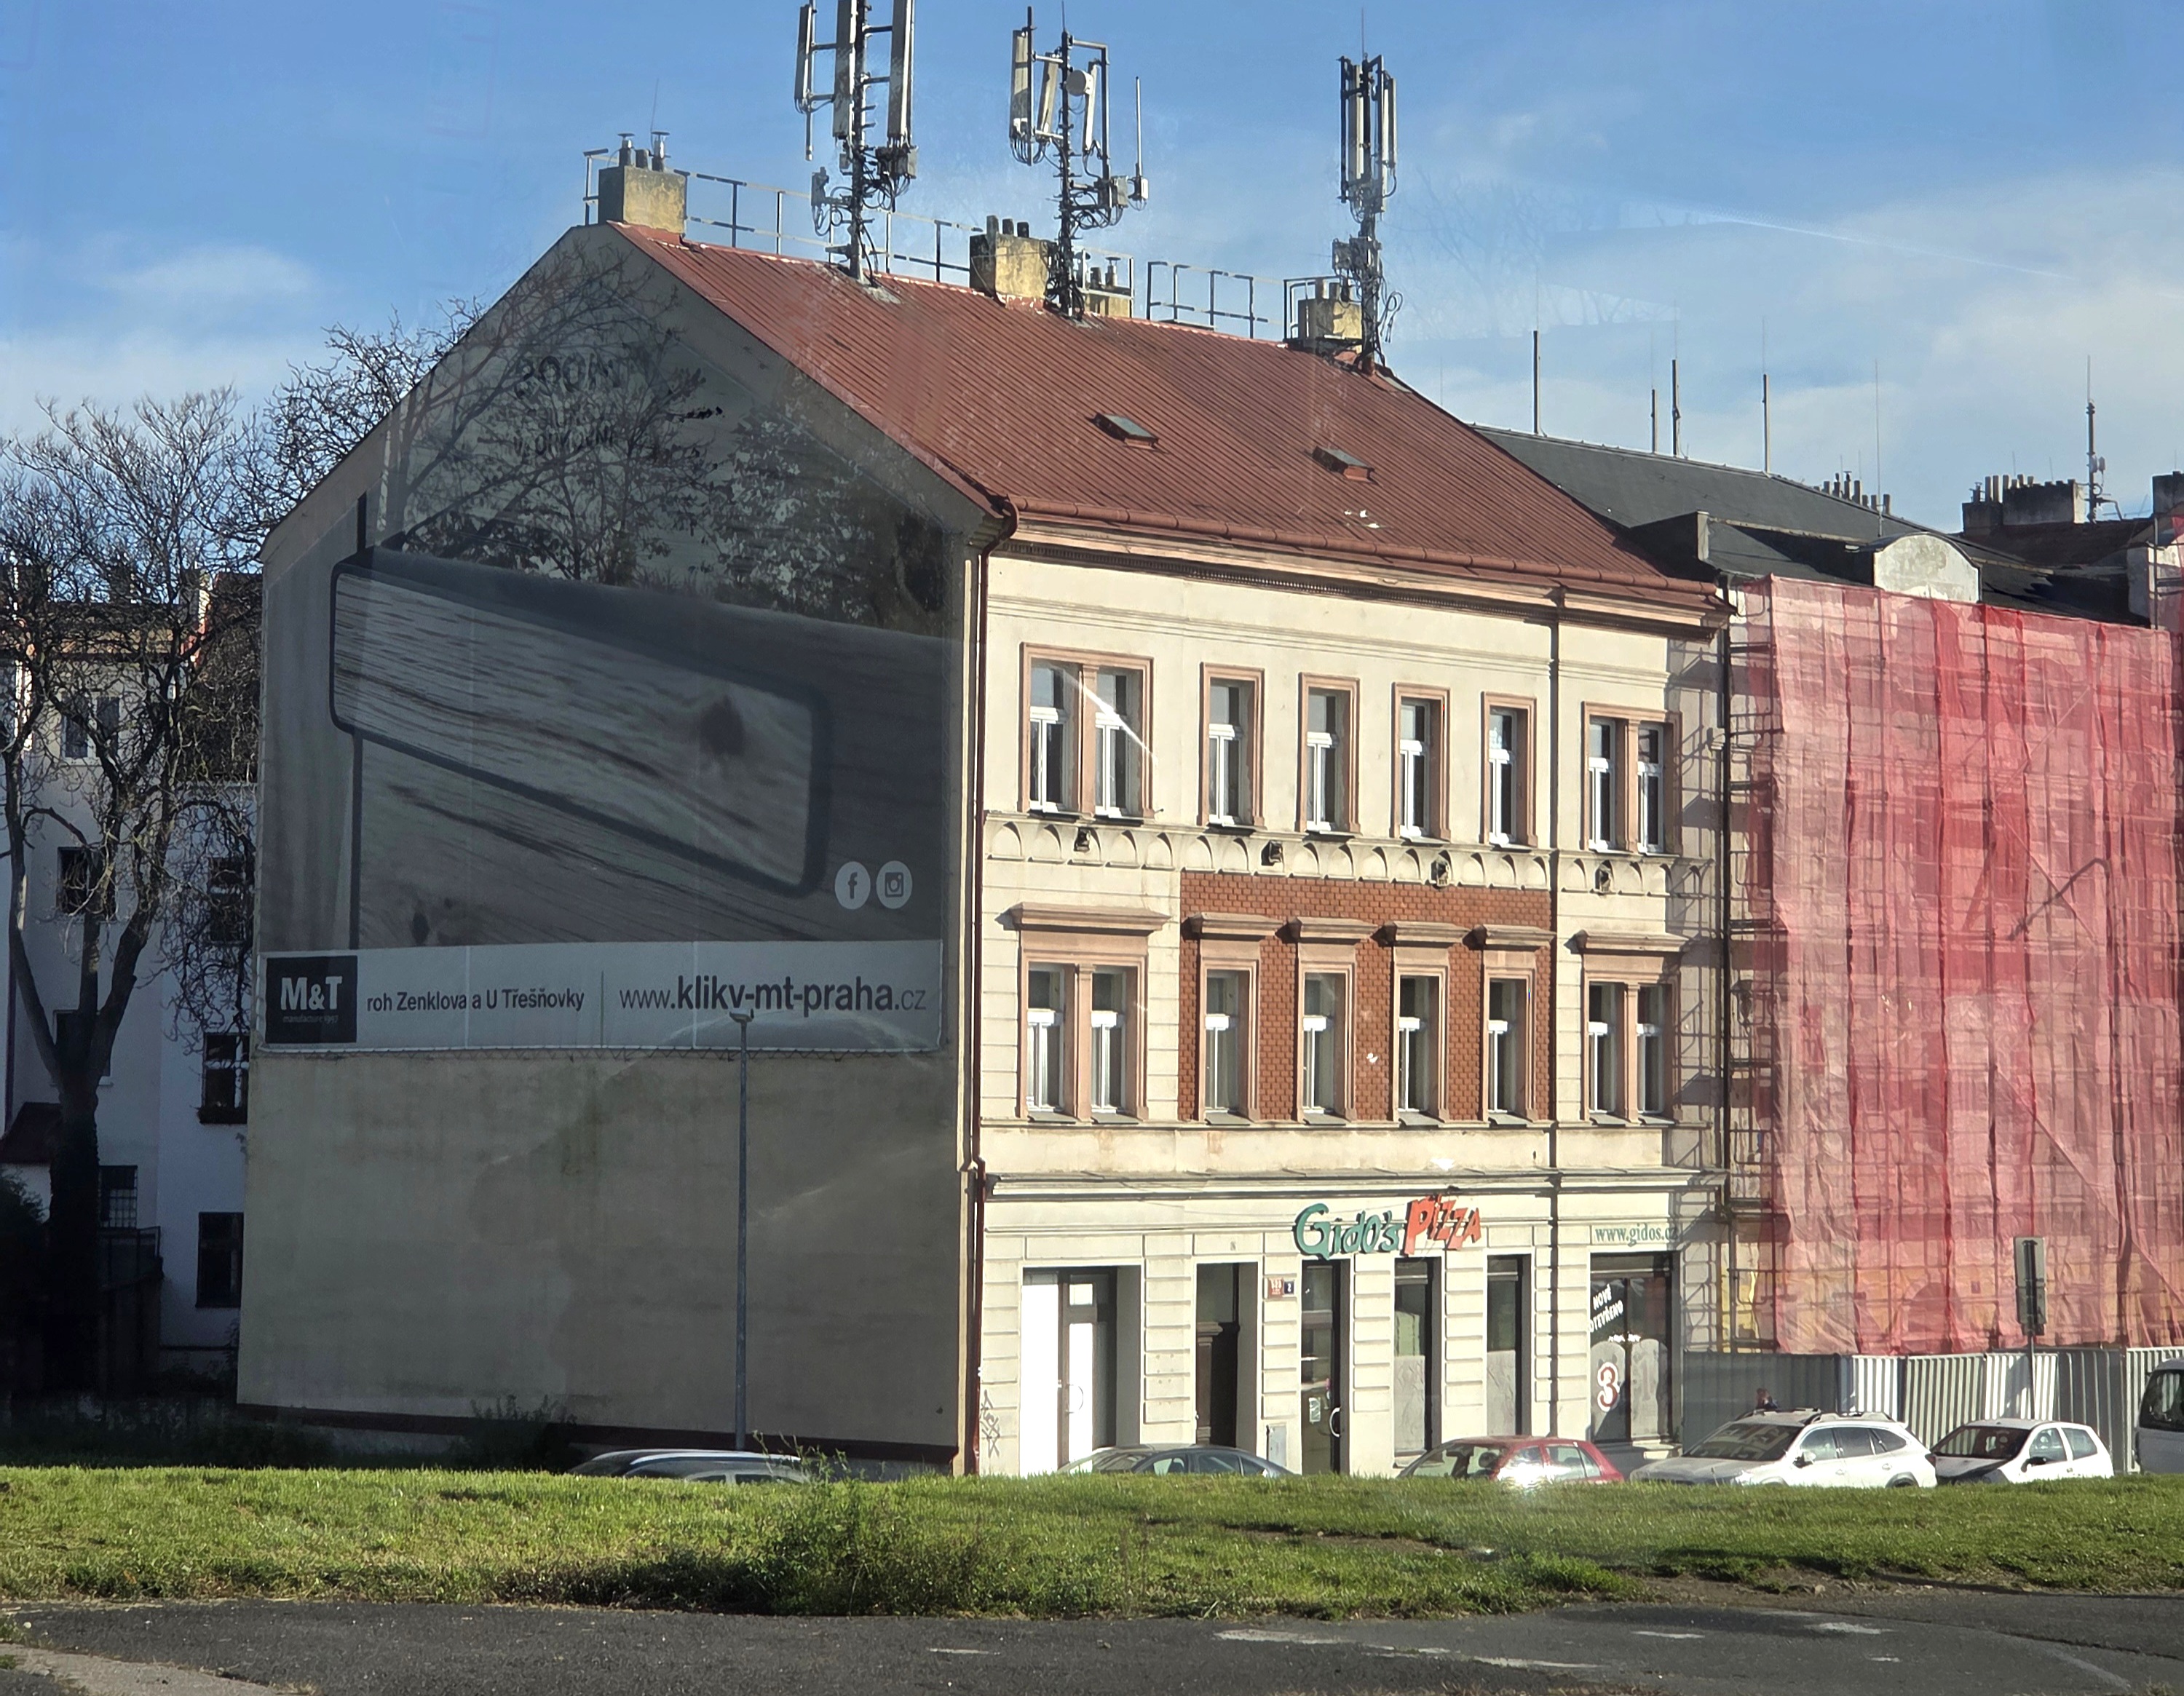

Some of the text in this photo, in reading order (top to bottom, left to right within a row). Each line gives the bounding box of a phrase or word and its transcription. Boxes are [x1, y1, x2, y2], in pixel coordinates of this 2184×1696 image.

[280, 976, 343, 1010] M&T
[367, 987, 585, 1012] roh Zenklova a U Třešňovky
